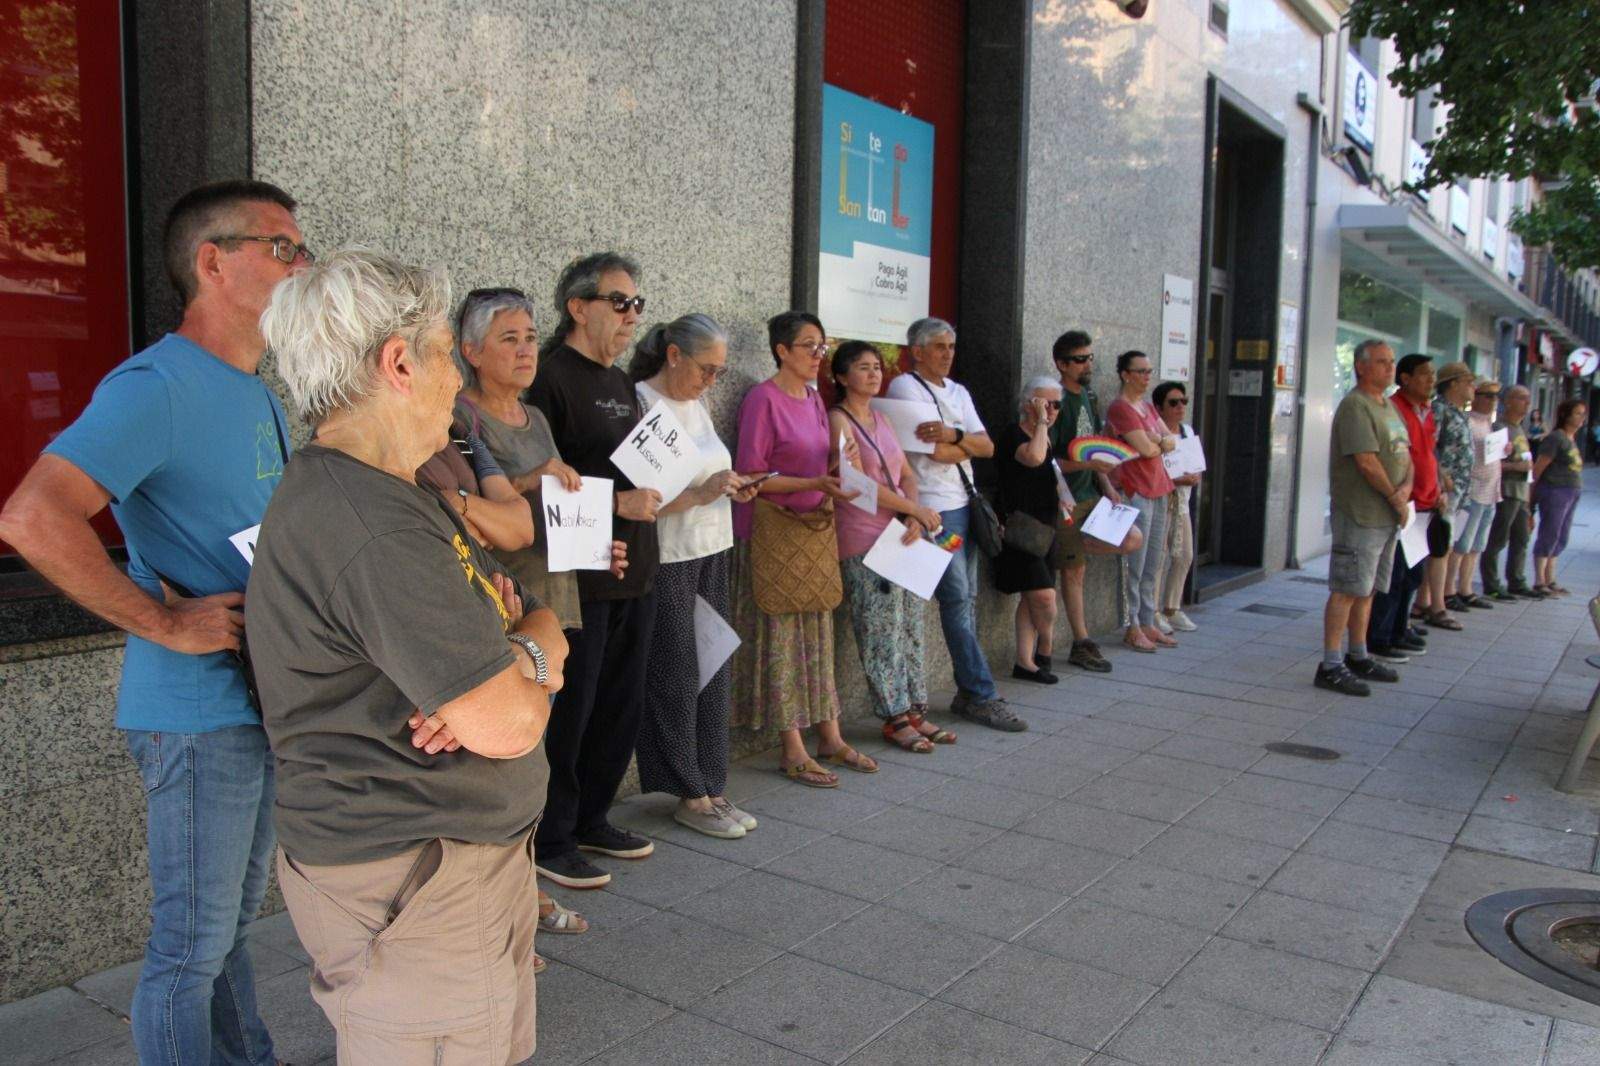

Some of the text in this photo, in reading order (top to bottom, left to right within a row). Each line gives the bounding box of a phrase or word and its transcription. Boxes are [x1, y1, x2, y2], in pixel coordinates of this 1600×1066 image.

[840, 122, 853, 144] Si
[869, 132, 882, 153] te
[839, 195, 861, 217] San
[867, 202, 886, 224] tan
[878, 261, 894, 278] Pago
[875, 276, 894, 290] Cobro
